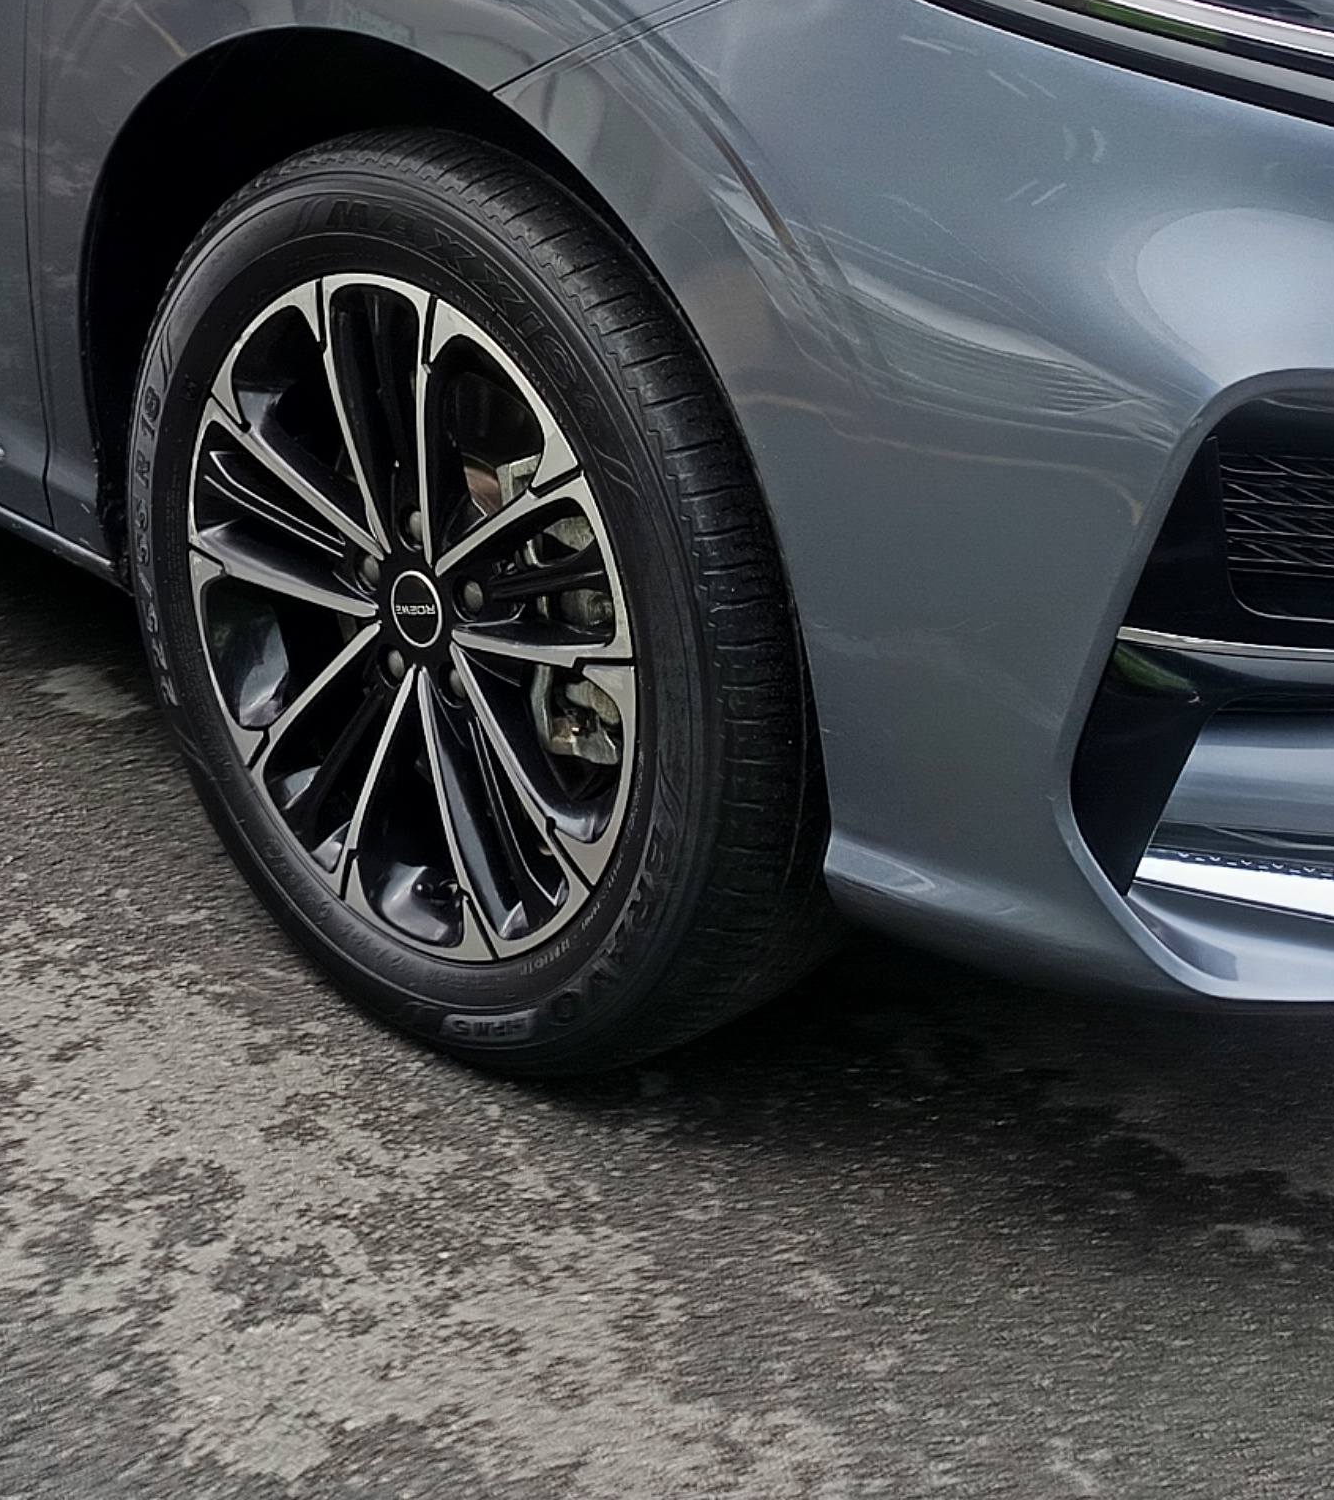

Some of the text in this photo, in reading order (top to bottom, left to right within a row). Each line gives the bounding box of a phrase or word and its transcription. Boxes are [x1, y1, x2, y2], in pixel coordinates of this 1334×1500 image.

[326, 199, 577, 389] MAXXIS
[134, 449, 152, 489] R
[134, 501, 178, 707] 225/55
[395, 603, 436, 615] ROEWE
